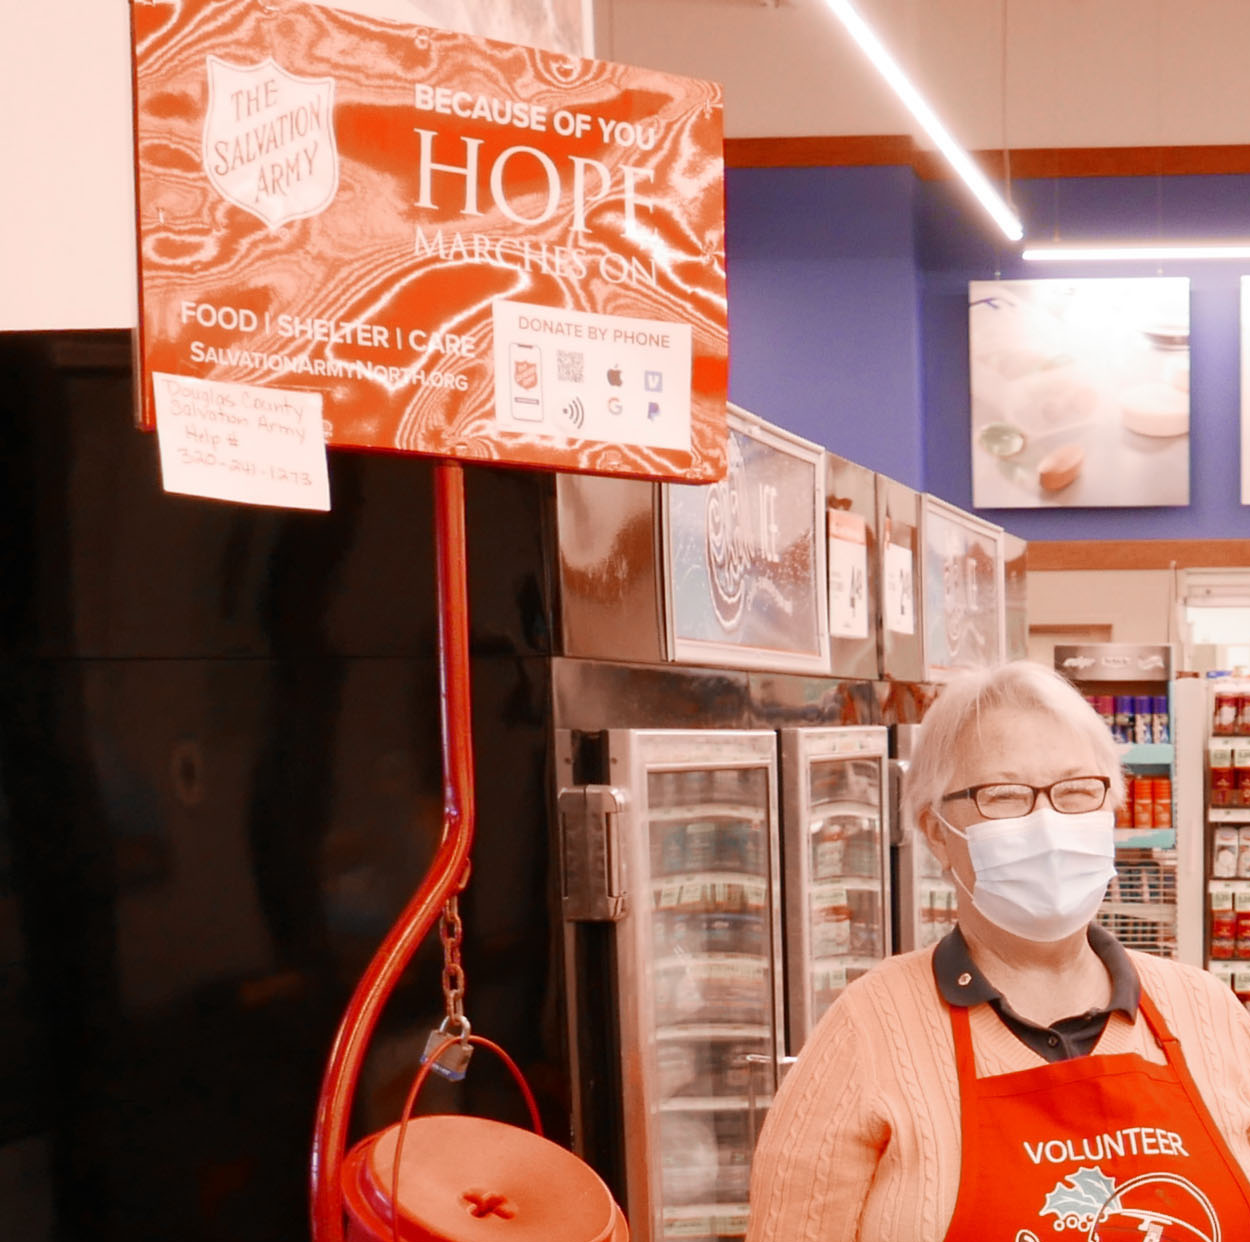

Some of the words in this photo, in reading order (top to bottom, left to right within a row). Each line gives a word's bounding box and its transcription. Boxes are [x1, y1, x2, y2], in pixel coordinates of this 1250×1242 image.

[231, 80, 279, 121] THE
[414, 83, 547, 131] BECAUSE
[553, 110, 592, 138] OF
[598, 117, 656, 150] YOU
[214, 94, 321, 176] SALVATION
[255, 141, 318, 203] ARMY
[413, 128, 656, 237] HOPE
[413, 226, 587, 280] MARCHES
[600, 252, 657, 288] ON
[181, 301, 258, 332] FOOD
[278, 316, 390, 348] SHELTER
[408, 330, 477, 358] CARE
[518, 316, 583, 338] DONATE
[587, 326, 608, 341] BY
[613, 329, 671, 348] PHONE
[168, 381, 236, 408] Douglas
[241, 392, 304, 424] County
[170, 399, 249, 425] Salvation
[258, 415, 306, 443] Army
[185, 424, 221, 450] Help
[1023, 1127, 1189, 1164] VOLUNTEER
